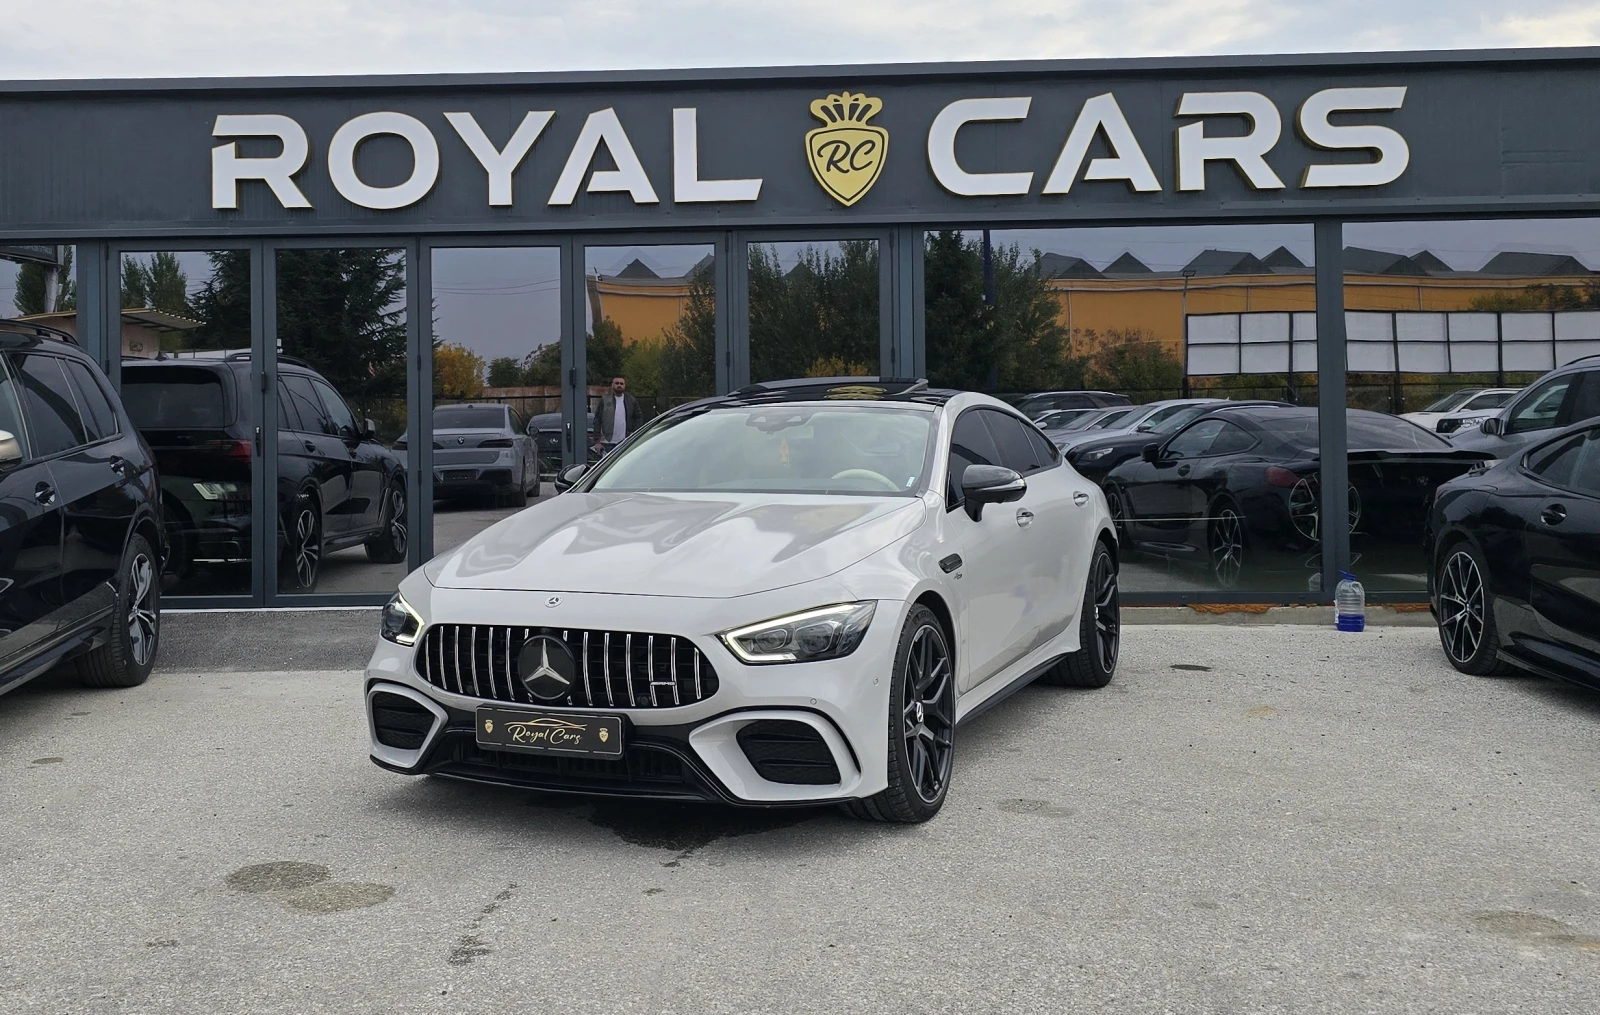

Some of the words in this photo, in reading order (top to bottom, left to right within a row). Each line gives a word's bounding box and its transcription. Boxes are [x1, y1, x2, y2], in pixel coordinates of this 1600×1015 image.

[210, 106, 764, 211] ROYAL
[926, 85, 1411, 197] CARS
[816, 139, 877, 174] RC
[507, 724, 550, 743] Royal
[550, 728, 583, 745] Cars
